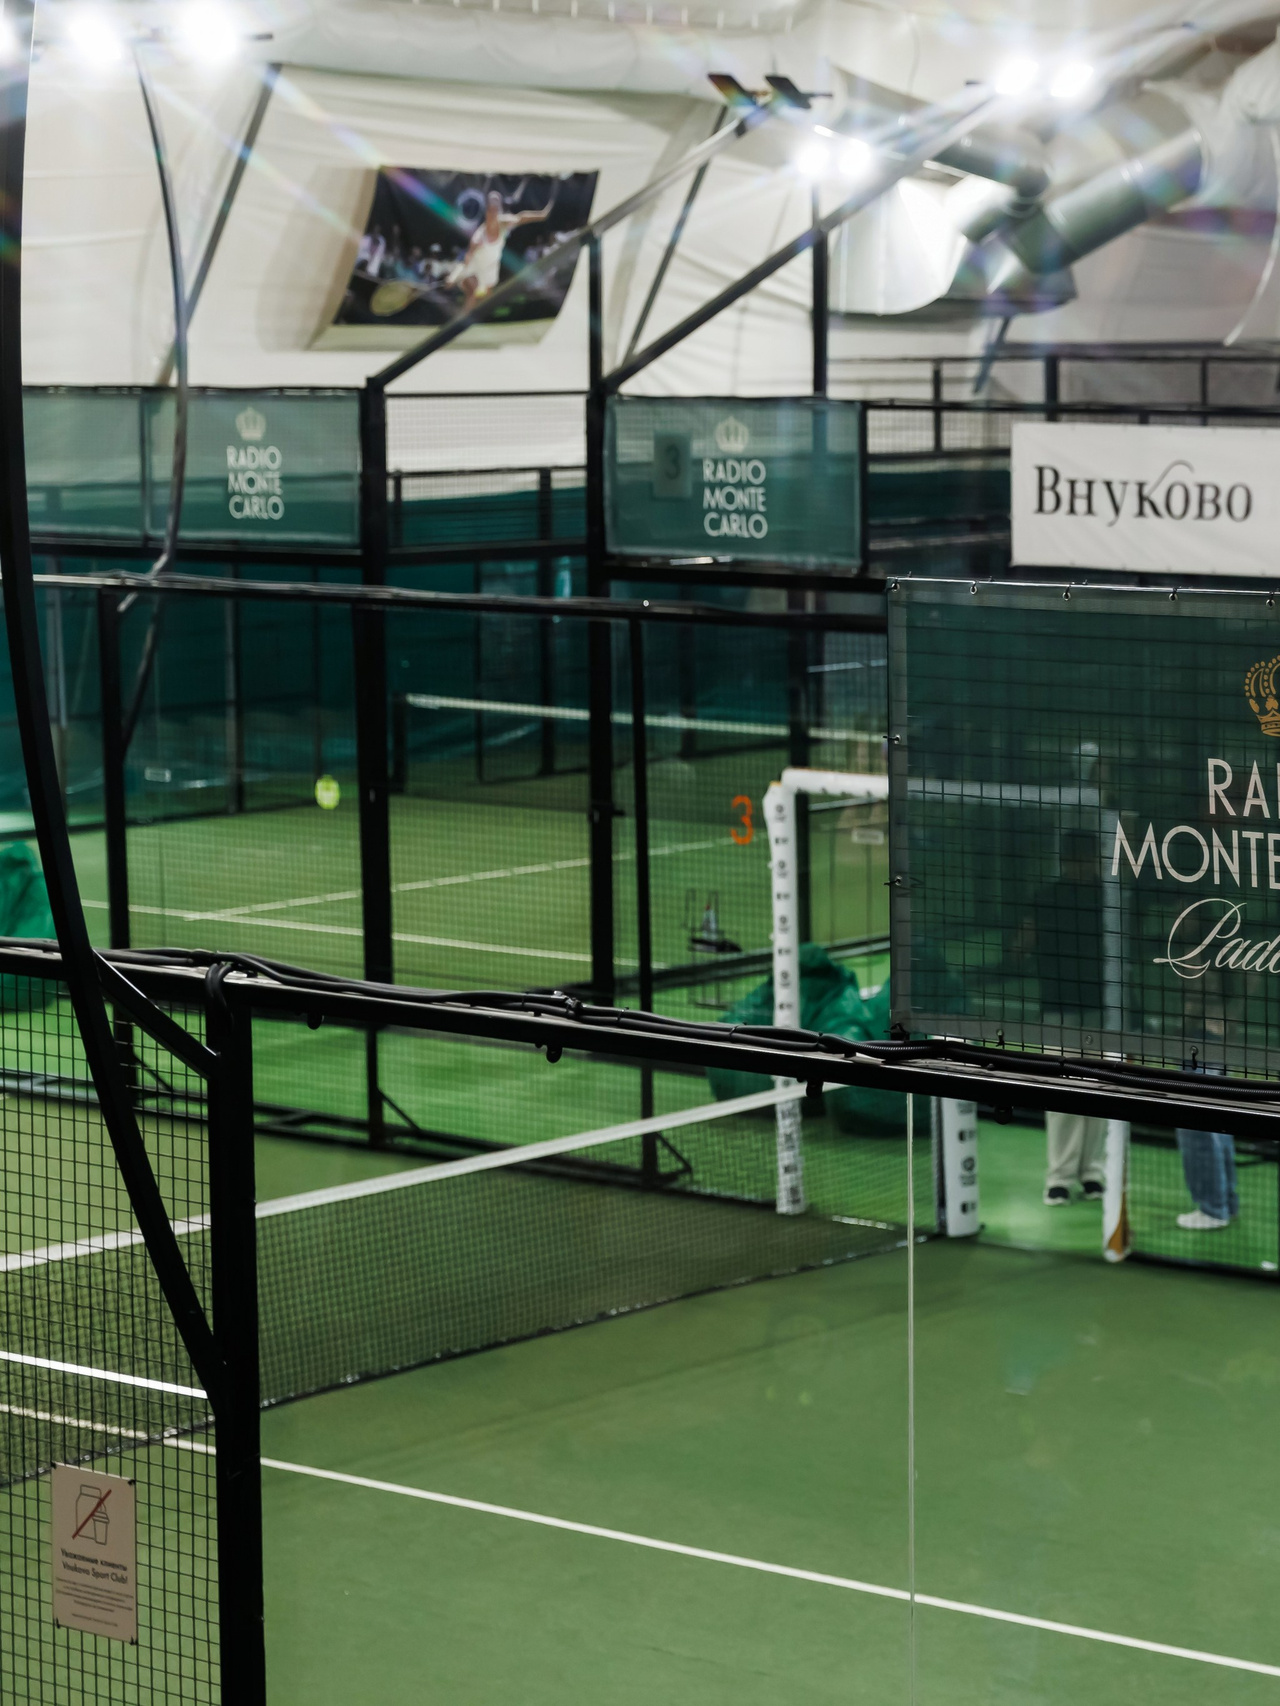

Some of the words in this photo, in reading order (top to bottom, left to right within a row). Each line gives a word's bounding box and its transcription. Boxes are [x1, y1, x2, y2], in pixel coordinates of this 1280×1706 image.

[226, 446, 282, 470] RADIO
[703, 458, 767, 485] RADIO
[228, 471, 283, 495] MONTE
[1033, 460, 1253, 527] Внуково
[229, 495, 285, 520] CARLO
[703, 485, 767, 512] MONTE
[704, 511, 769, 539] CARLO
[730, 794, 755, 845] 3
